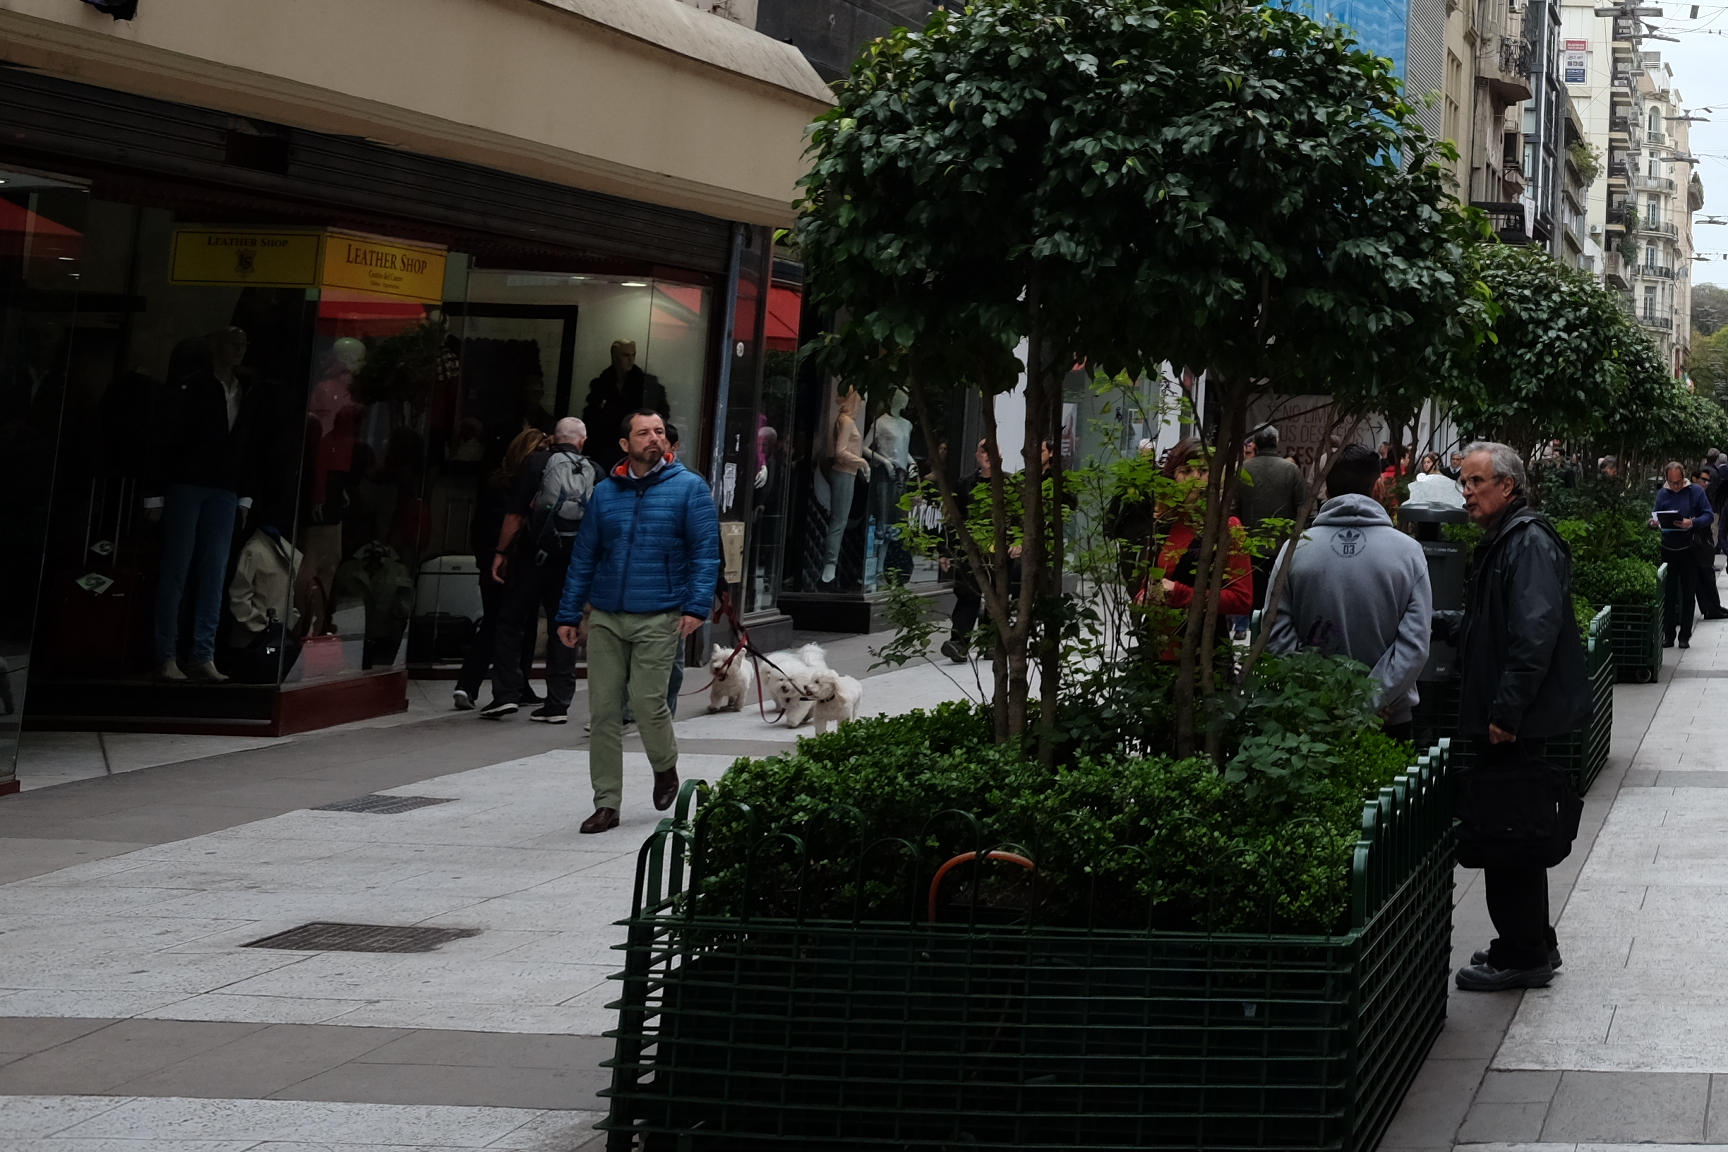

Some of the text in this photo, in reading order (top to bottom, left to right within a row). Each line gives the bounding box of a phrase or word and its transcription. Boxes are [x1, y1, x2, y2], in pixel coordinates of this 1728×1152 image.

[207, 236, 289, 248] LEATHER SHOP
[346, 244, 427, 275] LEATHER SHOP
[1343, 544, 1355, 555] 03
